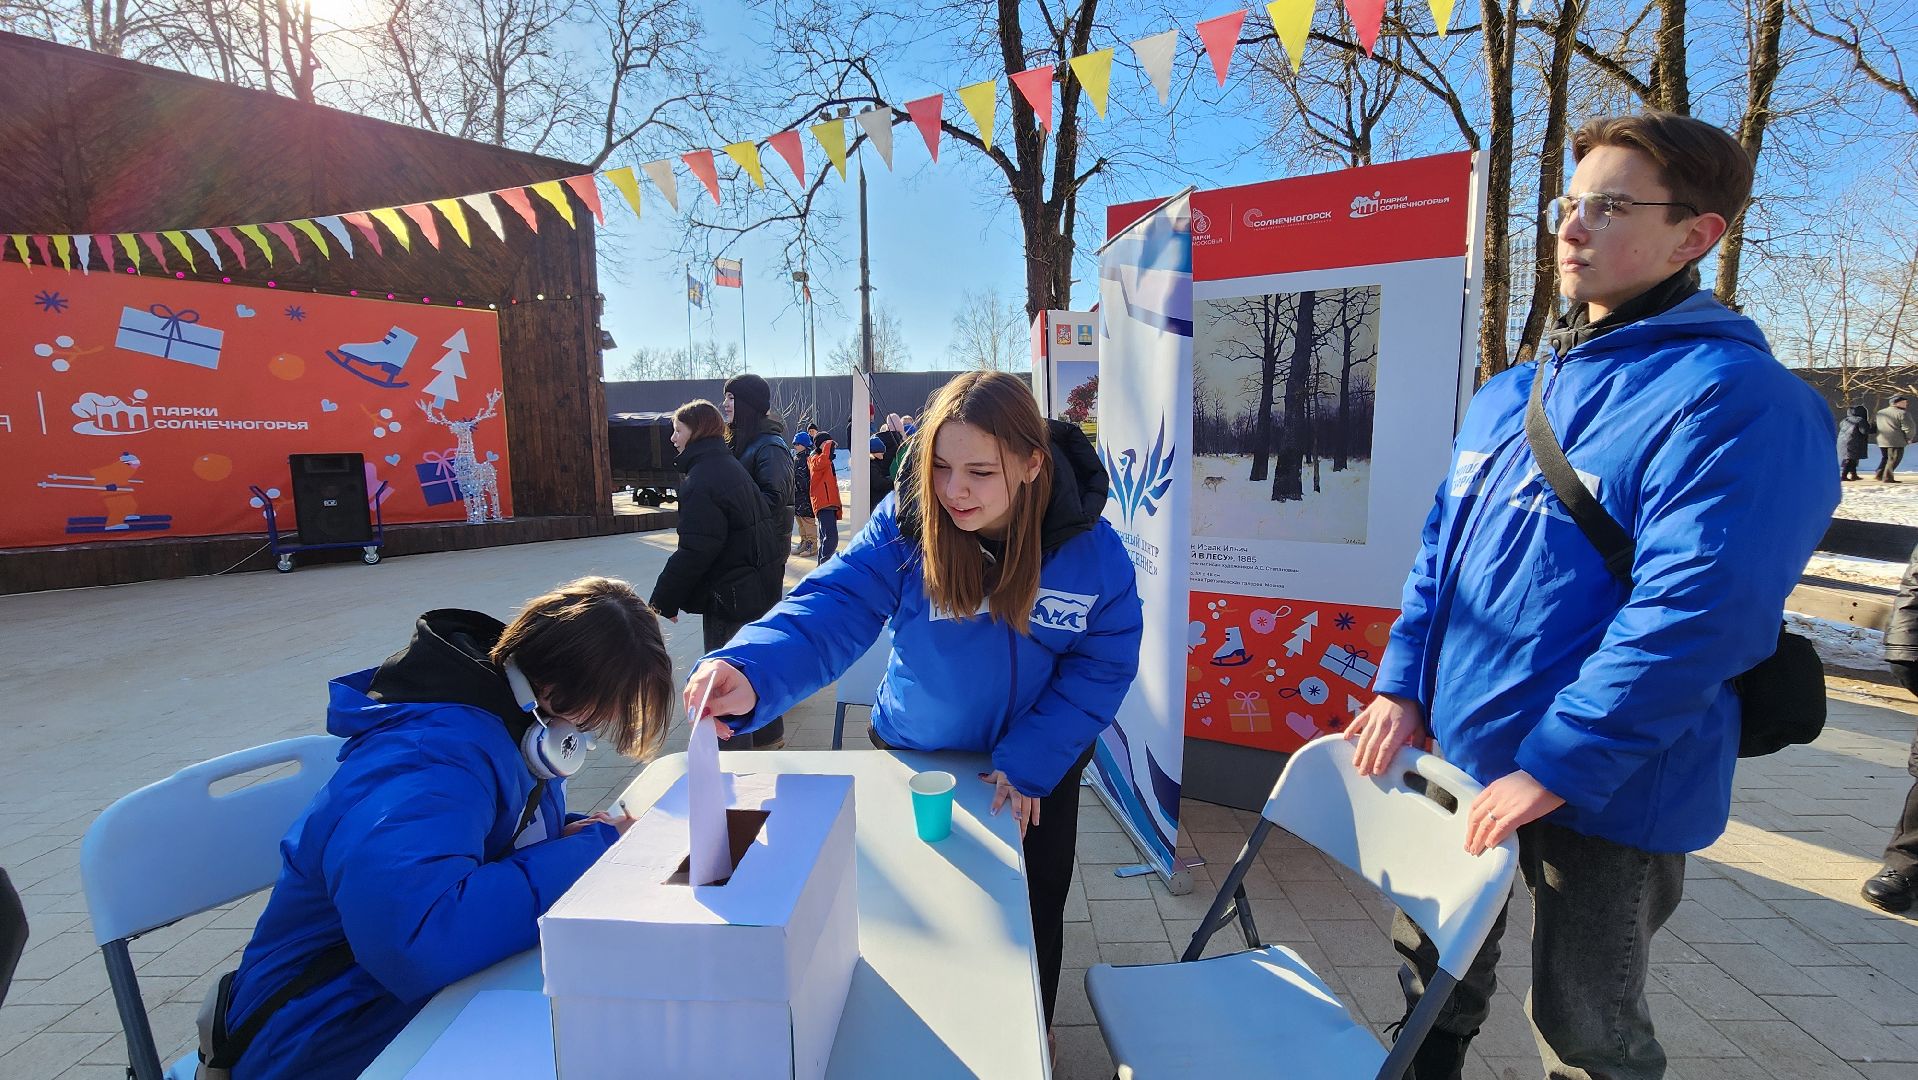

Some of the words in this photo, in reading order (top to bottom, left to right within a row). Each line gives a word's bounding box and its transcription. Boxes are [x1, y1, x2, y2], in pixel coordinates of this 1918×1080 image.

[1379, 195, 1408, 205] ПАРКИ
[1379, 197, 1450, 212] СОЛНЕЧНОГОРЬЯ
[1253, 211, 1332, 228] СОЛНЕЧНОГОРСК
[152, 406, 219, 417] ПАРКИ
[153, 419, 309, 431] СОЛНЕЧНОГОРЬЯ
[1238, 555, 1257, 563] 1885
